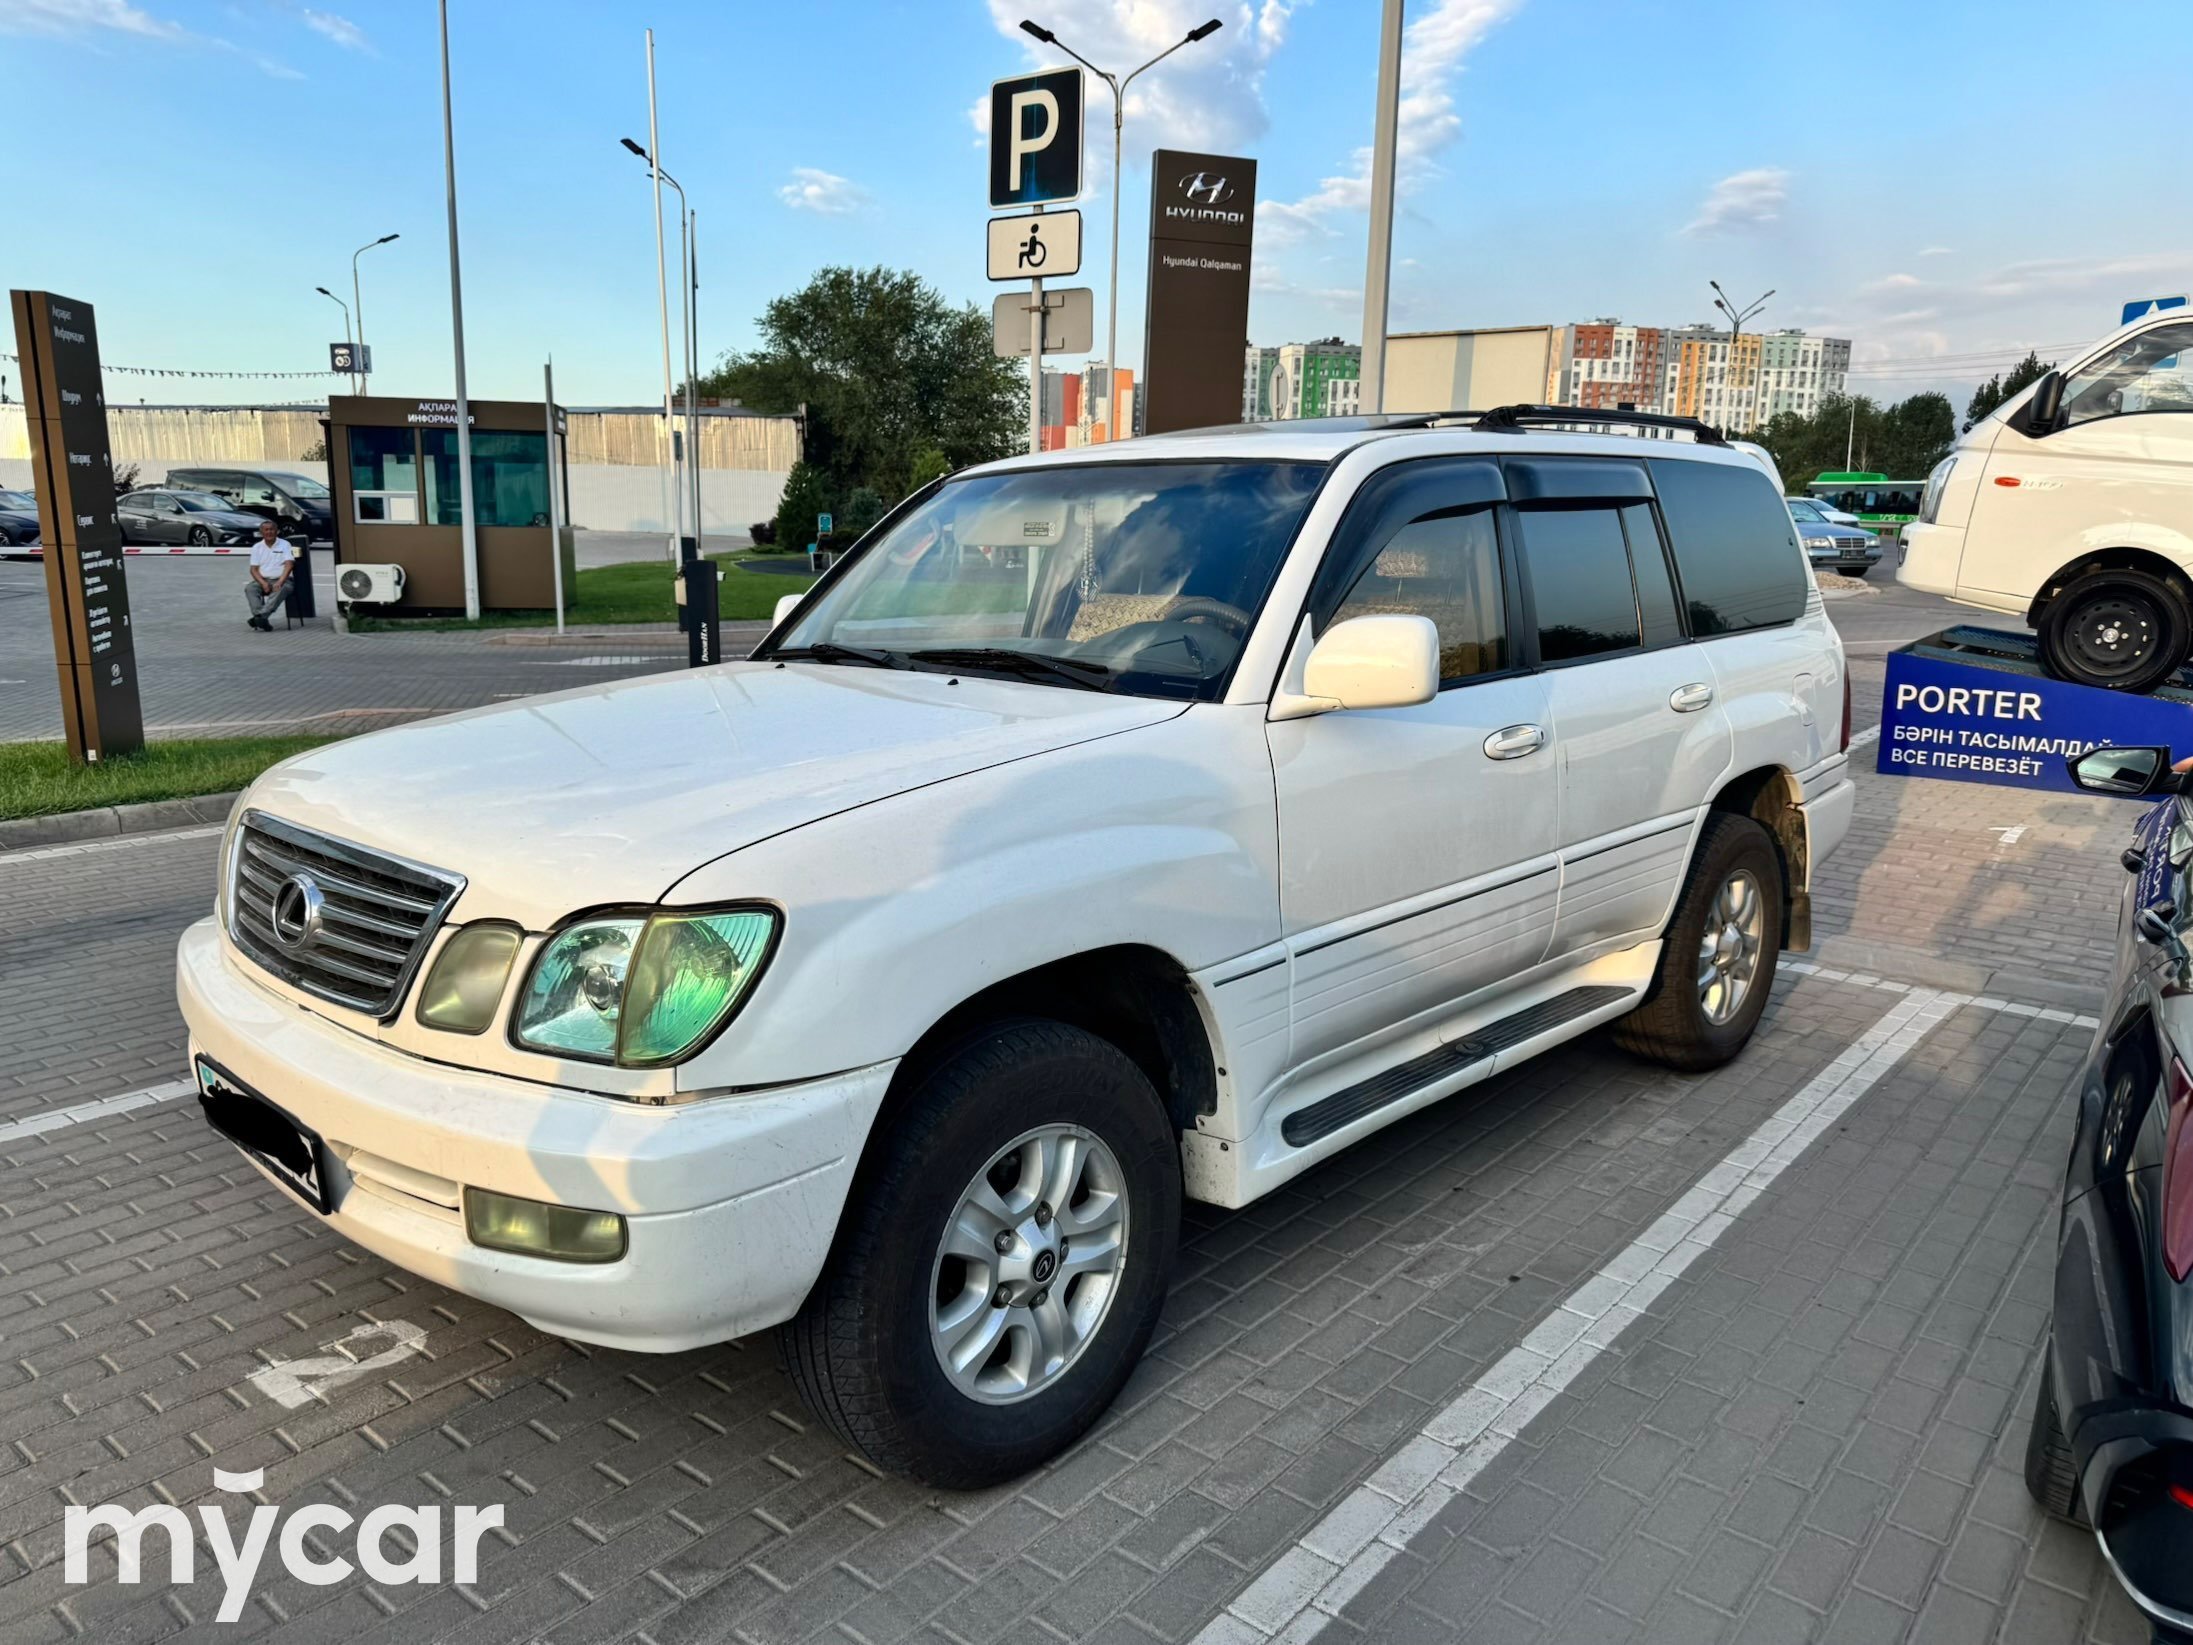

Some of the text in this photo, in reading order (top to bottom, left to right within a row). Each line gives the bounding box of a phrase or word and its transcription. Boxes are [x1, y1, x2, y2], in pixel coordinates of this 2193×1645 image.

[1009, 88, 1060, 192] P
[1166, 206, 1244, 223] HYUNDAI
[1163, 255, 1242, 271] Hyundai Qalqaman
[418, 402, 458, 412] АҚПАРА
[407, 413, 475, 425] ИНФОРМАЯ
[1896, 683, 2042, 721] PORTER
[1893, 725, 1953, 744] БӘРІН
[1891, 748, 2043, 776] ВСЕ ПЕРЕВЕЗЁТ
